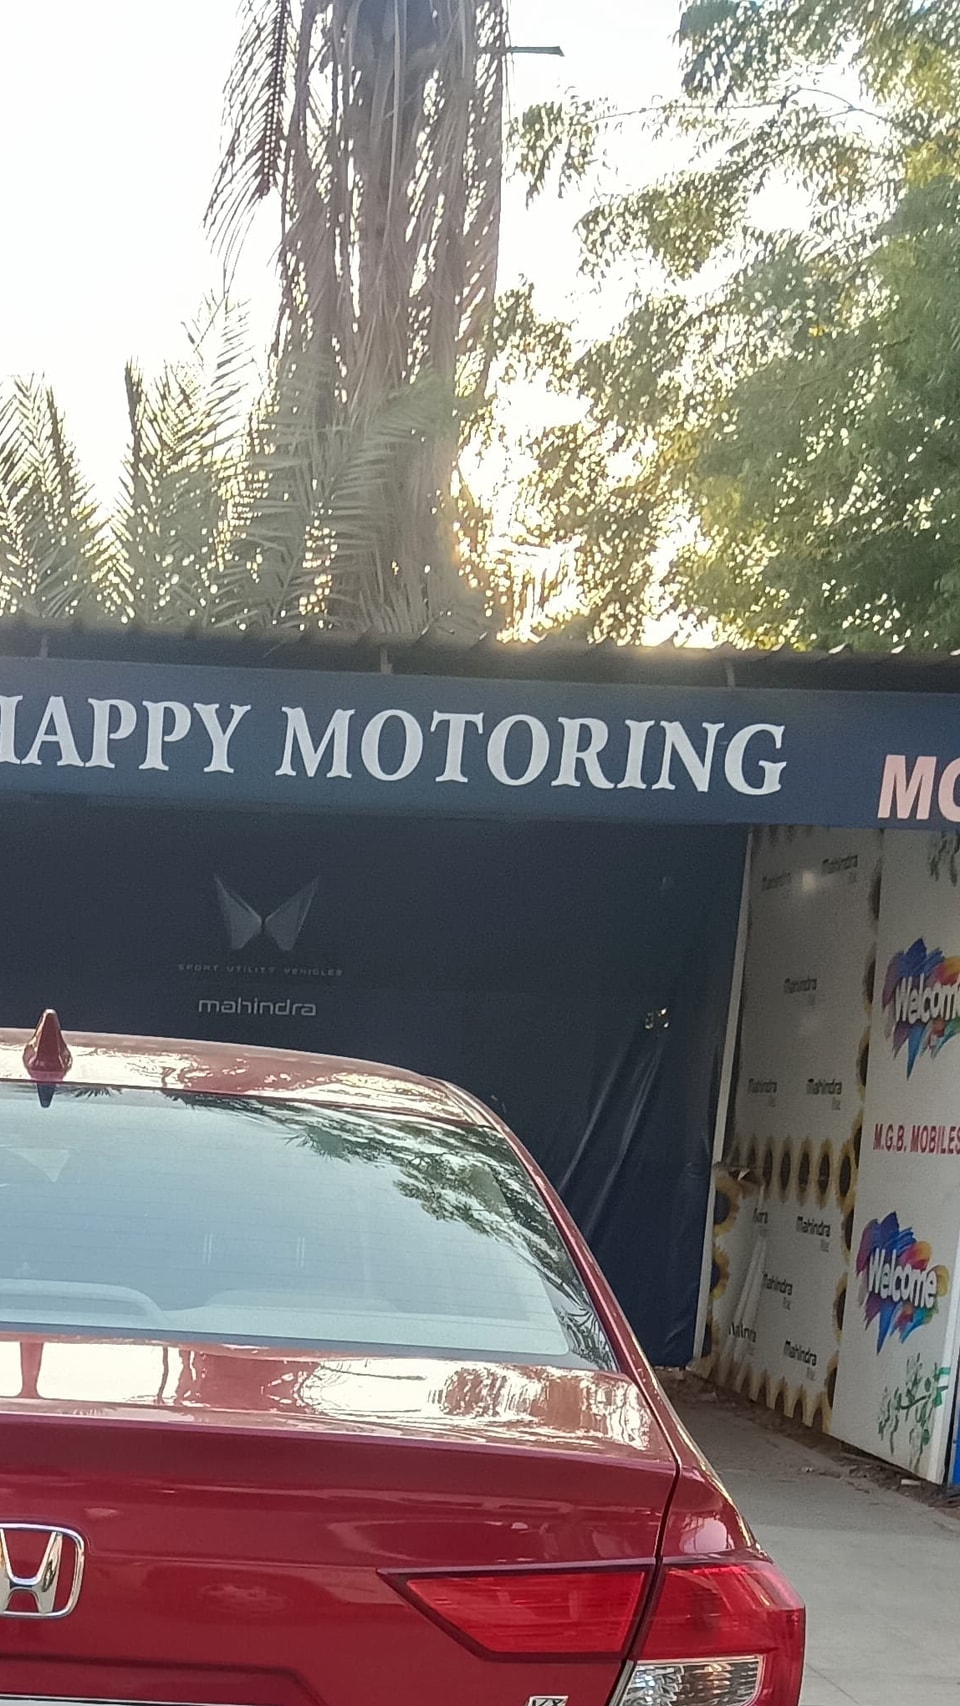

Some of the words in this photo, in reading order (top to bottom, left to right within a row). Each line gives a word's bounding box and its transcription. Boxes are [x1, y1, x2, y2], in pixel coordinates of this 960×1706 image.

[276, 707, 786, 795] MOTORING
[178, 963, 219, 972] SPORT
[227, 965, 275, 974] UTILITY
[283, 967, 343, 977] VEHICLES
[198, 997, 317, 1017] mahindra
[873, 1123, 907, 1152] M.G.B.
[869, 1247, 937, 1309] Welcome
